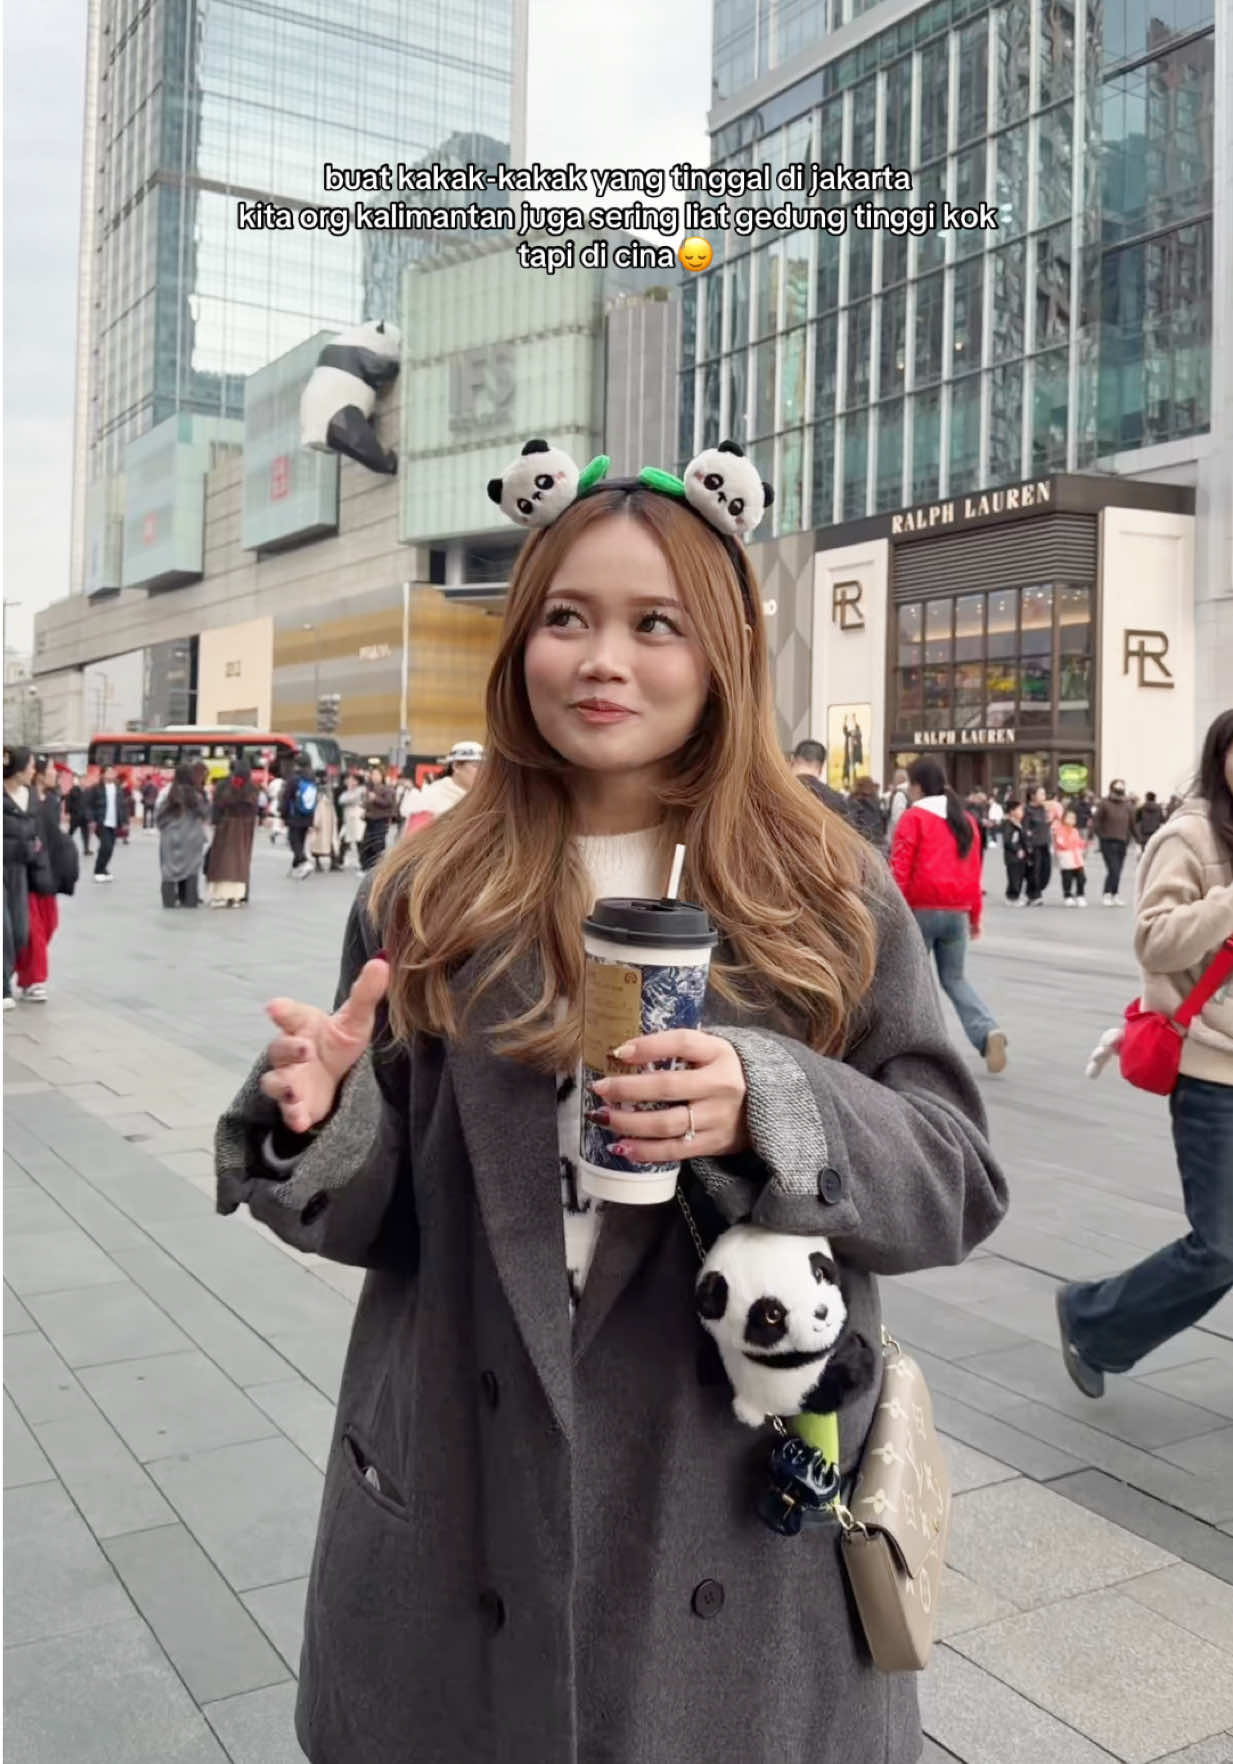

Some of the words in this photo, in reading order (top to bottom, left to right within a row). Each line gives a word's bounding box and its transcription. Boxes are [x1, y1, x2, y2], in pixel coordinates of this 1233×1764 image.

[891, 501, 955, 535] RALPH
[964, 480, 1050, 519] LAUREN
[914, 730, 956, 745] RALPH
[961, 728, 1016, 745] LAUREN
